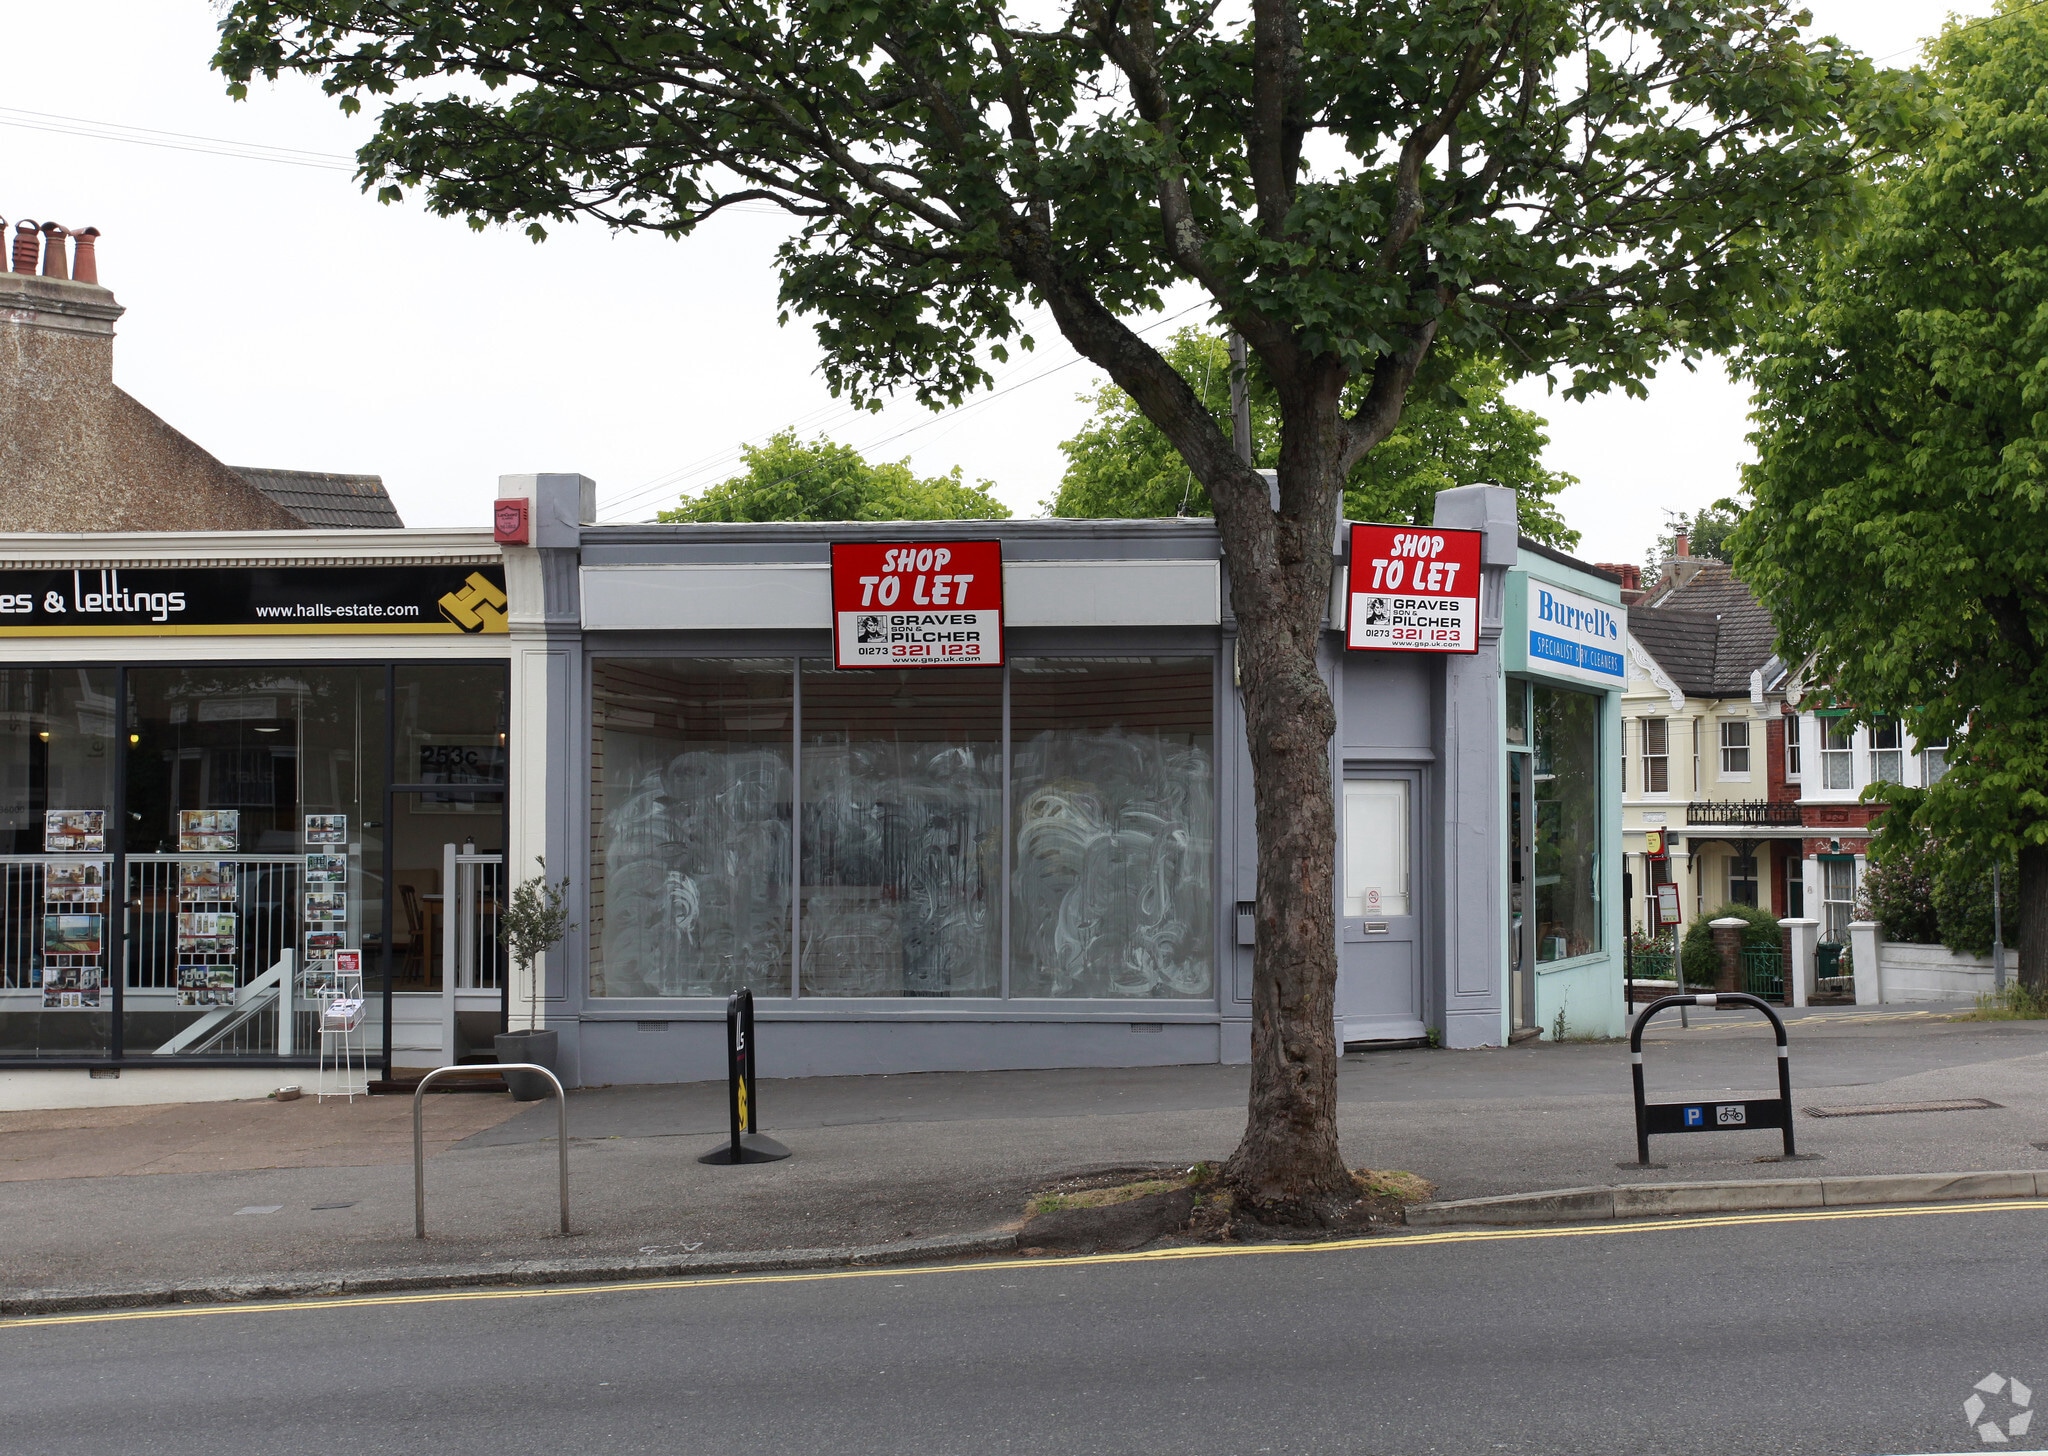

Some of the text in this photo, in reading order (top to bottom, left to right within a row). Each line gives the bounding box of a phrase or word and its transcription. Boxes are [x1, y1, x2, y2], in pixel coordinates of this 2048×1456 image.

[1390, 533, 1445, 559] SHOP
[882, 547, 951, 573] SHOP
[1371, 558, 1461, 592] TO LET
[0, 569, 186, 622] es & lettings
[858, 574, 975, 607] TO LET
[256, 603, 419, 617] www.halls-estate.com
[1393, 599, 1459, 611] GRAVES
[890, 614, 977, 626] GRAVES
[1538, 589, 1617, 640] Burrell's
[1392, 616, 1461, 628] PILCHER
[891, 631, 980, 643] PILCHER
[1365, 628, 1461, 641] 01273 321 123
[858, 644, 981, 656] 01273 321 123
[1392, 640, 1461, 648] www.gsp.uk.com
[892, 655, 981, 664] www.gsp.uk.com
[1537, 636, 1573, 659] SPECIALIST
[1590, 651, 1618, 671] CLEANERS
[1688, 1108, 1700, 1125] P
